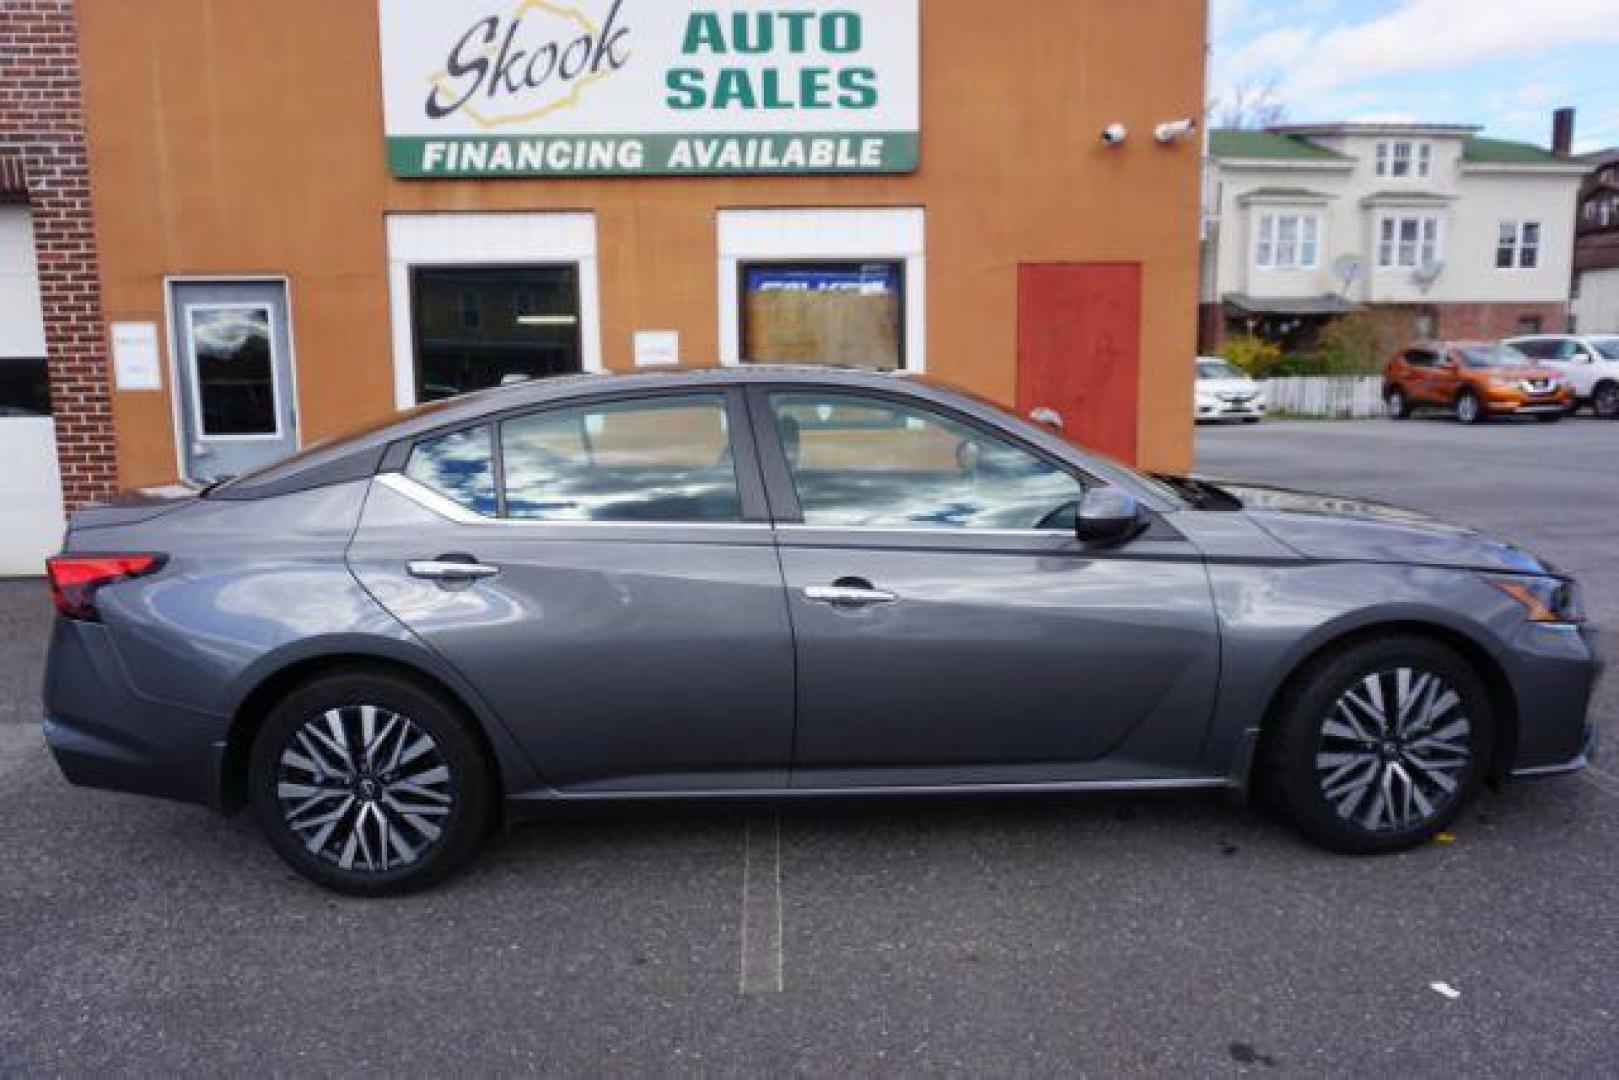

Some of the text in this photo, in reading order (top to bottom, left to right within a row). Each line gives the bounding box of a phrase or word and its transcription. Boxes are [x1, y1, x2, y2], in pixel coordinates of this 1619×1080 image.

[682, 10, 863, 54] AUTO
[425, 0, 630, 119] Skook
[665, 67, 879, 110] SALES
[422, 138, 885, 171] FINANCING AVAILABLE
